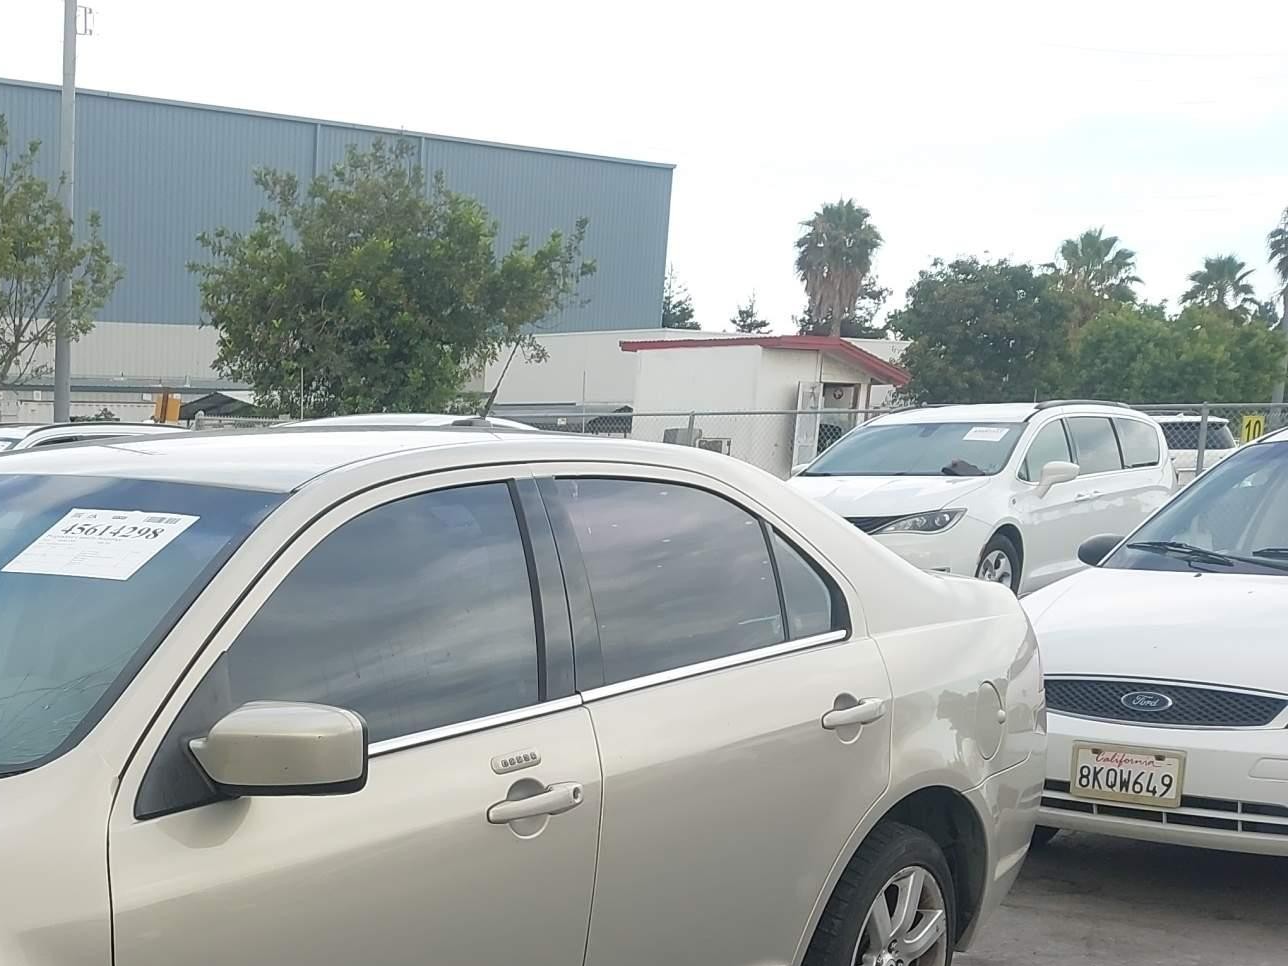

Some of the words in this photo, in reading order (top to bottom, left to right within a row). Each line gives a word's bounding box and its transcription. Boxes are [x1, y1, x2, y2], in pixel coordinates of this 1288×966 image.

[1245, 420, 1261, 442] 10
[61, 522, 165, 540] 45614298
[1132, 695, 1160, 707] Ford
[1096, 752, 1158, 768] California
[1078, 766, 1173, 797] 8KQW649
